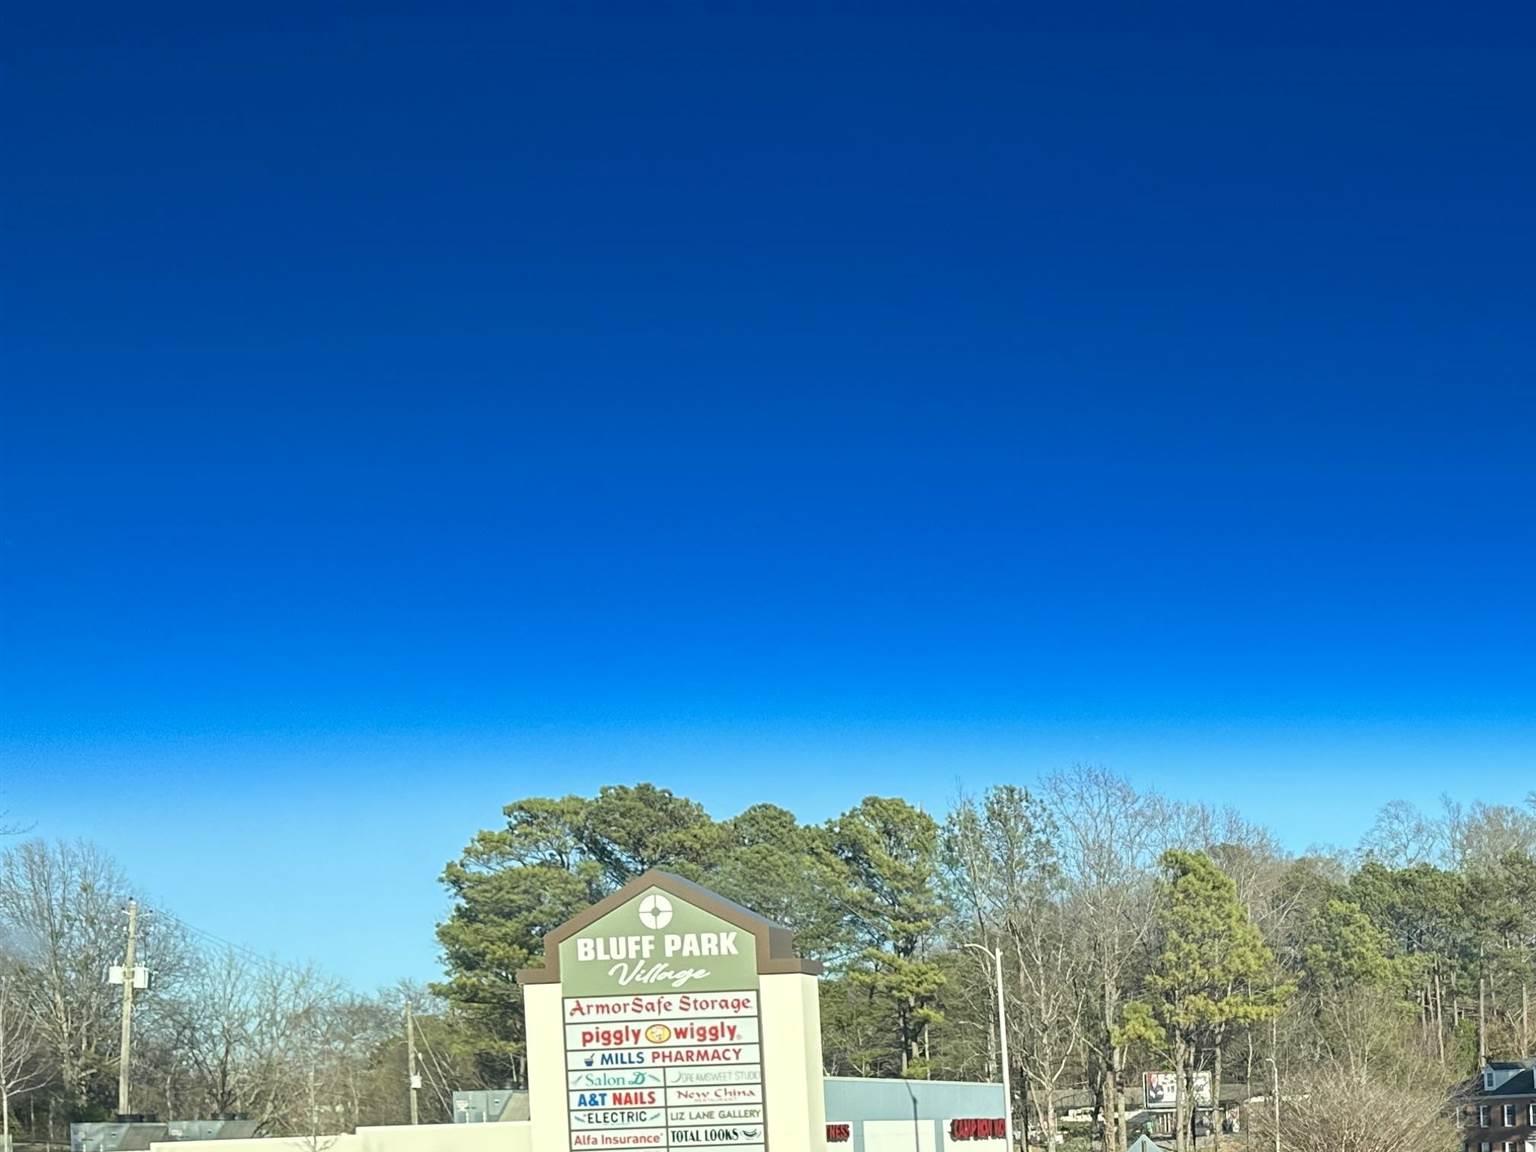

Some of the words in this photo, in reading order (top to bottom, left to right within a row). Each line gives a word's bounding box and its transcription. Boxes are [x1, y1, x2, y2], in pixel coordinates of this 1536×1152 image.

[577, 935, 655, 961] BLUFF
[664, 932, 739, 957] PARK
[608, 959, 711, 988] Village
[569, 996, 673, 1017] ArmorSafe
[678, 995, 752, 1014] Storage
[581, 1025, 642, 1047] piggly
[673, 1021, 737, 1042] wiggly
[600, 1052, 645, 1065] MILLS
[651, 1048, 742, 1064] PHARMACY
[584, 1073, 626, 1087] Salon
[577, 1093, 608, 1107] A&T
[612, 1091, 656, 1106] NAILS
[676, 1090, 710, 1100] New
[714, 1087, 756, 1099] China
[587, 1111, 647, 1124] ELECTRIC
[670, 1112, 685, 1121] LIZ
[689, 1111, 715, 1120] LANE
[718, 1109, 761, 1119] GALLERY
[574, 1135, 598, 1146] Alfa
[601, 1134, 661, 1145] Insurance
[671, 1130, 701, 1143] TOTAL
[705, 1128, 739, 1142] LOOKS
